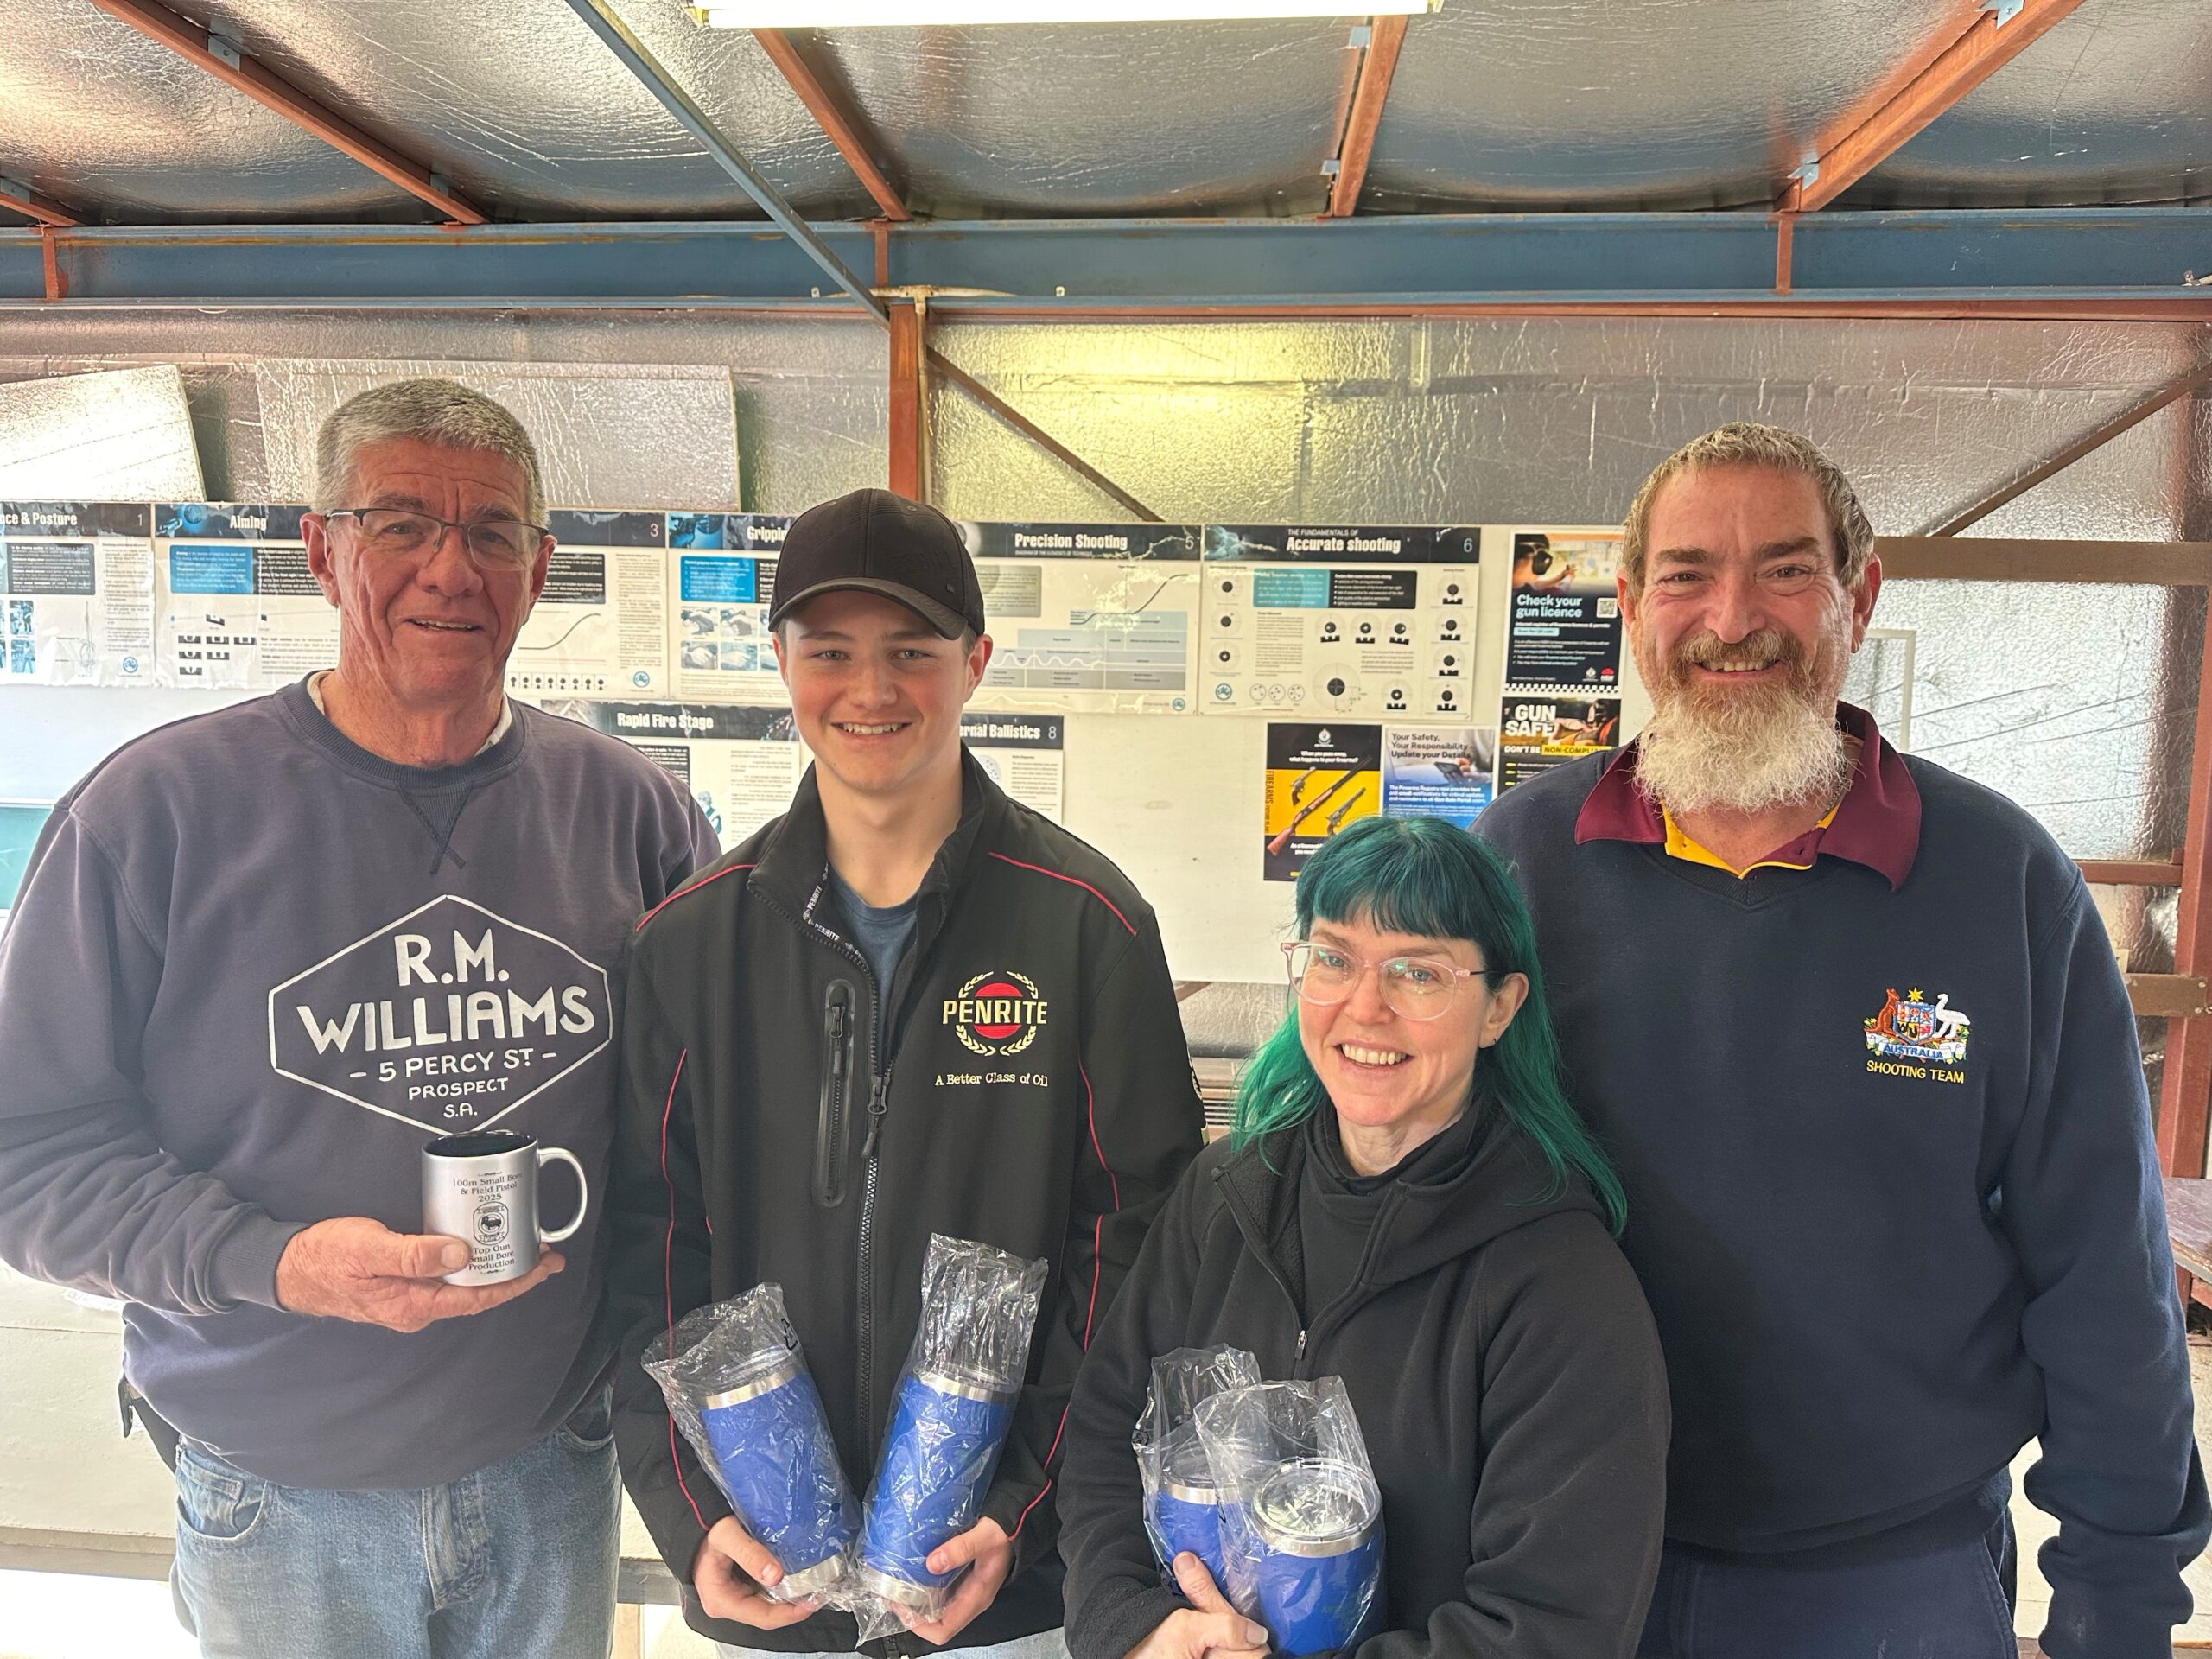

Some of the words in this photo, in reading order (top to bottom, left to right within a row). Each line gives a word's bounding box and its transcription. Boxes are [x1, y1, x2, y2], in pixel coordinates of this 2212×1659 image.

[21, 512, 30, 525] &
[32, 513, 78, 525] Posture
[137, 513, 143, 526] 1
[230, 515, 267, 531] Aiming
[650, 523, 658, 537] 3
[1014, 533, 1072, 548] Precision
[1075, 534, 1128, 551] Shooting
[1185, 536, 1194, 550] 5
[1287, 537, 1344, 551] Accurate
[1347, 537, 1402, 555] shooting
[1463, 537, 1472, 553] 6
[1517, 594, 1554, 606] Check
[1555, 598, 1583, 608] your
[1516, 608, 1540, 619] gun
[1541, 607, 1583, 618] licence
[1514, 703, 1557, 721] GUN
[617, 713, 650, 729] Rapid
[652, 714, 676, 728] Fire
[679, 715, 714, 730] Stage
[1505, 721, 1553, 738] SAFE
[988, 724, 1041, 740] Ballistics
[1047, 726, 1057, 740] 8
[1265, 771, 1274, 804] FIREARMS
[807, 885, 823, 910] PENRITE
[814, 923, 840, 942] PENRITE
[394, 928, 510, 987] R.M.
[296, 985, 594, 1055] WILLIAMS
[942, 1000, 1048, 1024] PENRITE
[1884, 1044, 1944, 1059] AUSTRALIA
[378, 1061, 396, 1082] 5
[405, 1052, 494, 1078] PERCY
[1866, 1059, 1926, 1079] SHOOTING
[1930, 1069, 1964, 1084] TEAM
[935, 1075, 944, 1085] A
[946, 1074, 982, 1085] Better
[985, 1072, 1016, 1084] Class
[1020, 1073, 1031, 1084] of
[1033, 1074, 1047, 1087] Oil
[409, 1077, 508, 1101] PROSPECT
[443, 1103, 477, 1118] S.A.
[480, 1177, 505, 1185] Small
[496, 1182, 517, 1192] Pistol
[479, 1193, 501, 1202] 2025
[469, 1254, 493, 1262] Small
[469, 1258, 515, 1270] Production
